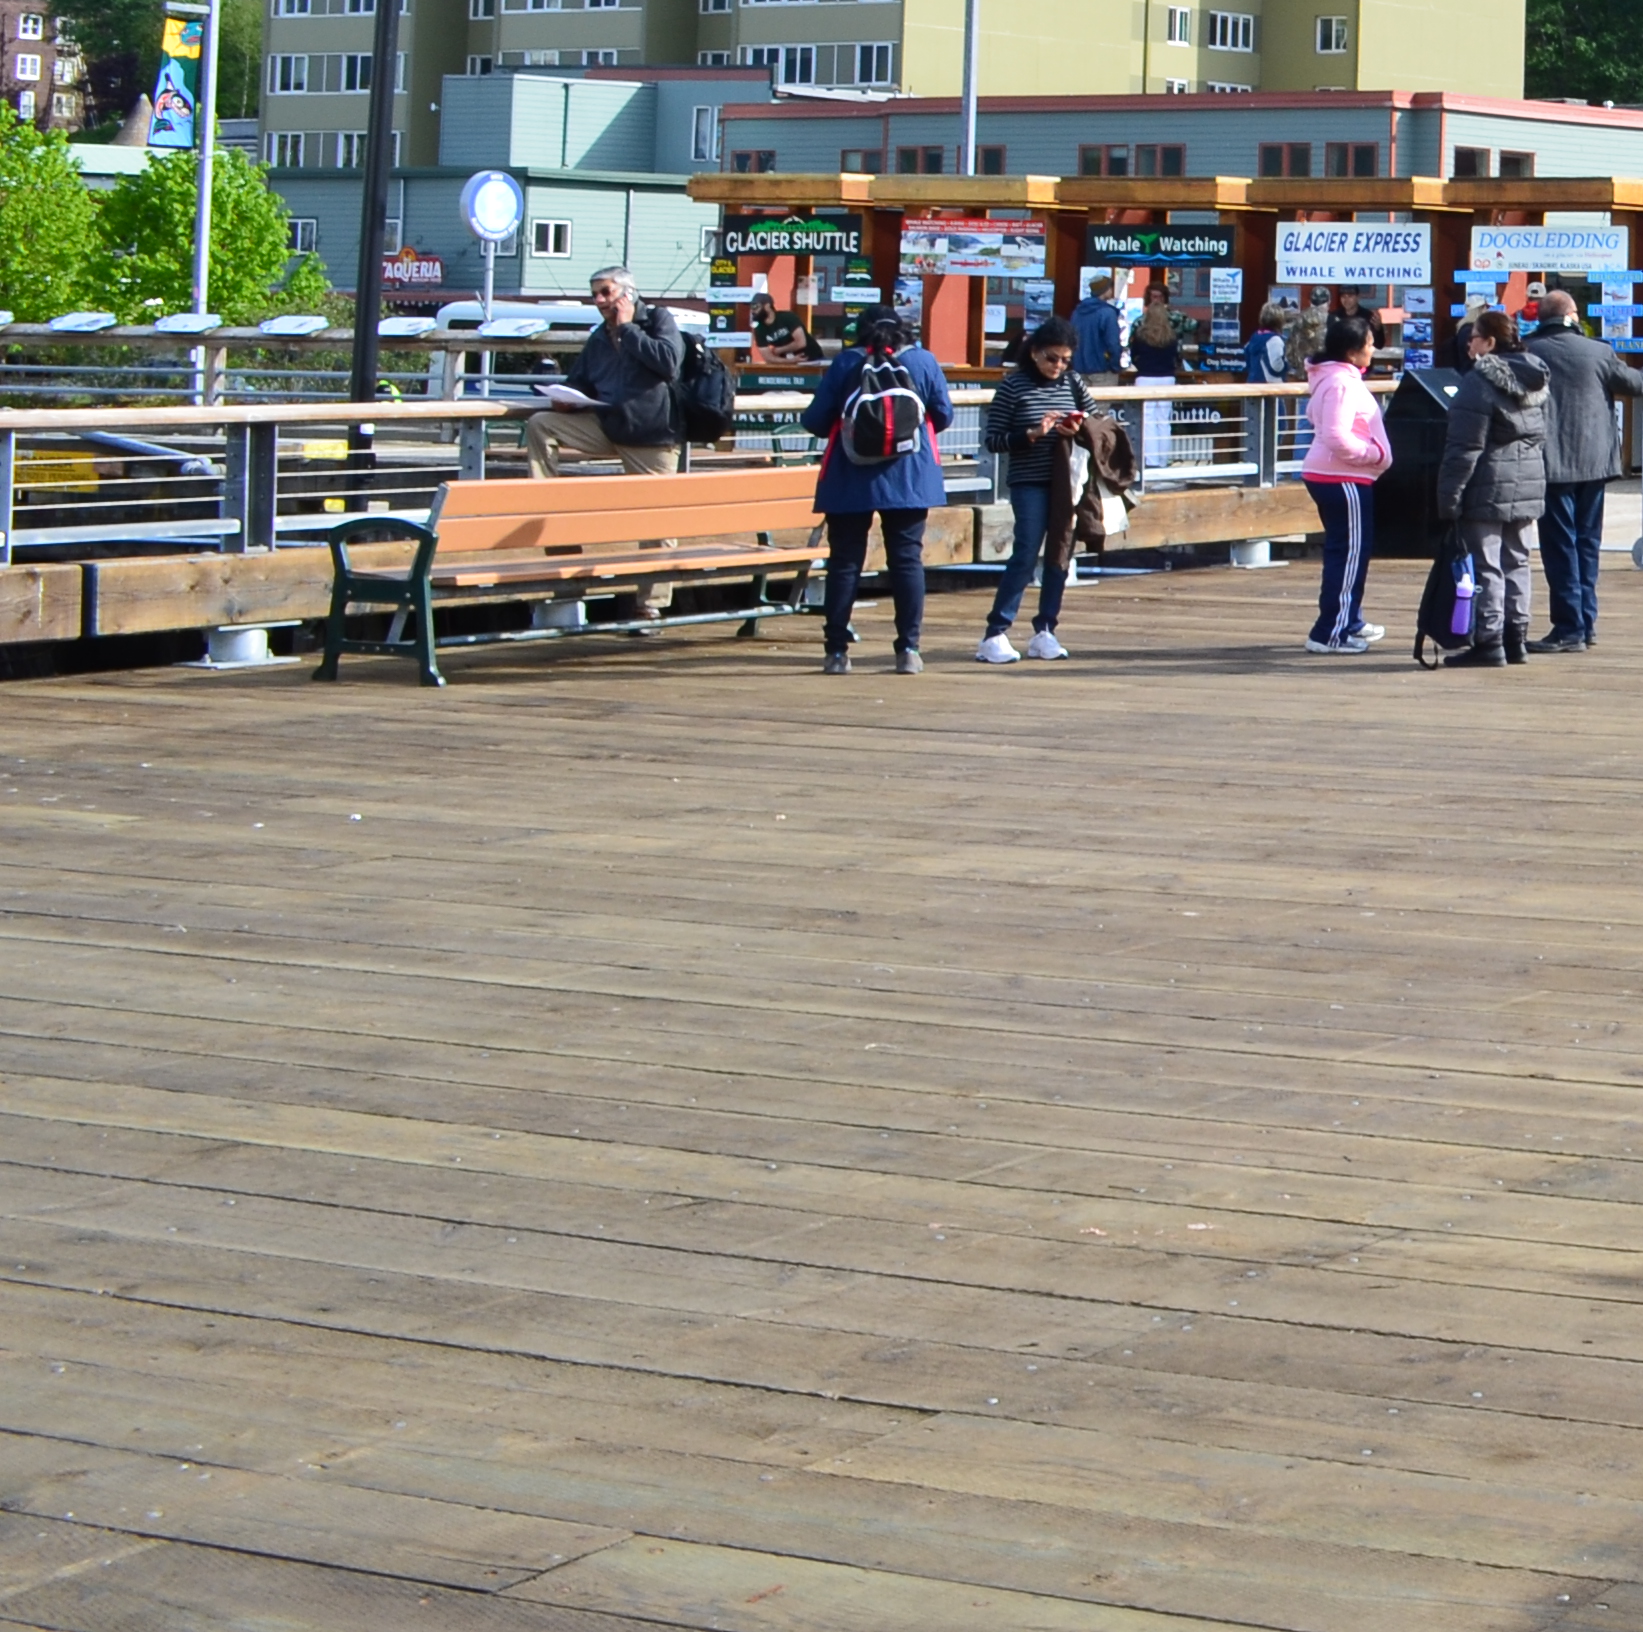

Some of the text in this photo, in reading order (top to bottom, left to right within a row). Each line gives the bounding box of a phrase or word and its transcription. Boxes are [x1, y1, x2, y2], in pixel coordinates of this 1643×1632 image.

[726, 231, 859, 253] GLACIER SHUTTLE
[1094, 236, 1228, 256] Whale Watching
[1284, 232, 1422, 253] GLACIER EXPRESS
[1479, 232, 1620, 250] DOGSLEDDING
[1285, 266, 1423, 279] WHALE WATCHING
[1216, 347, 1244, 355] Helicopte
[1206, 358, 1219, 368] Dog
[1170, 408, 1221, 423] huttle
